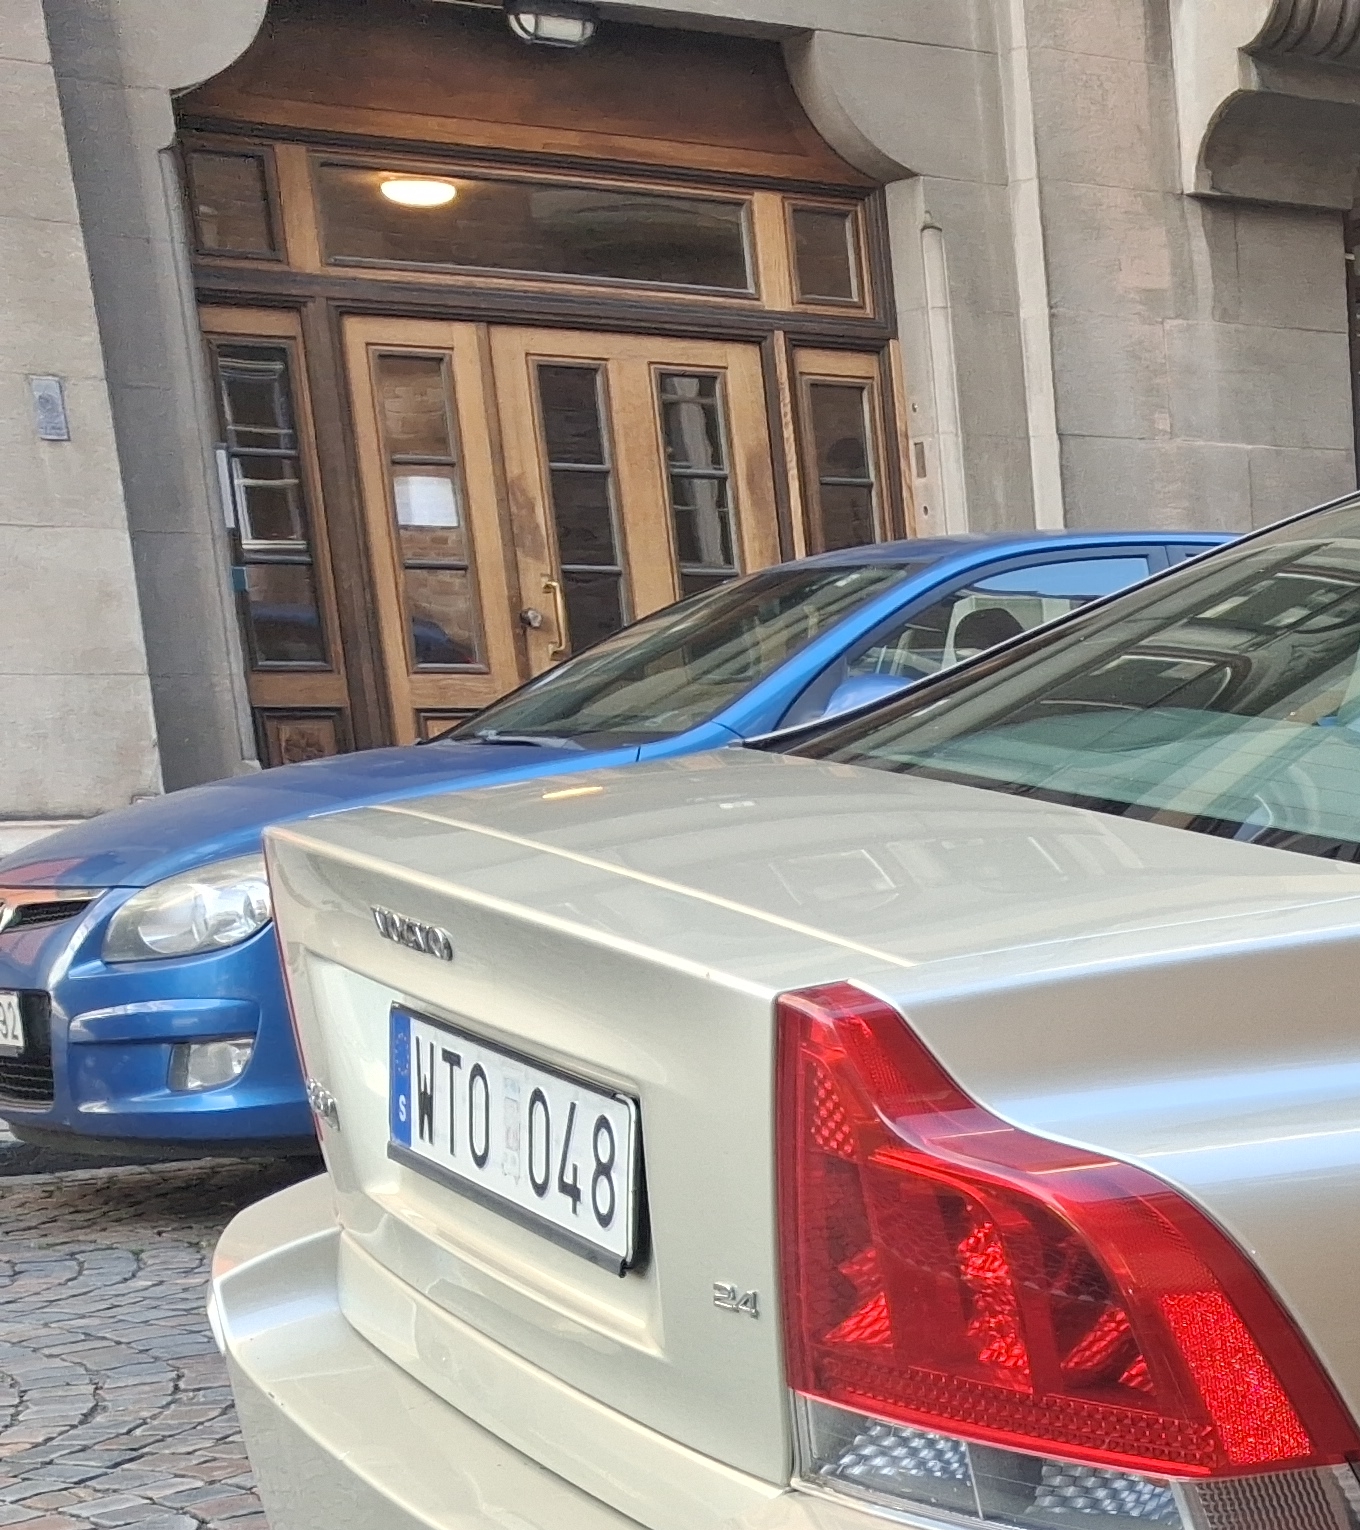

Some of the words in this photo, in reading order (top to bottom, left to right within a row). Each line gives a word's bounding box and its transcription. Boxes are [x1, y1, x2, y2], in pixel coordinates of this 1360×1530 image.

[398, 1094, 407, 1123] S
[416, 1035, 490, 1169] WTO
[528, 1086, 616, 1229] 048
